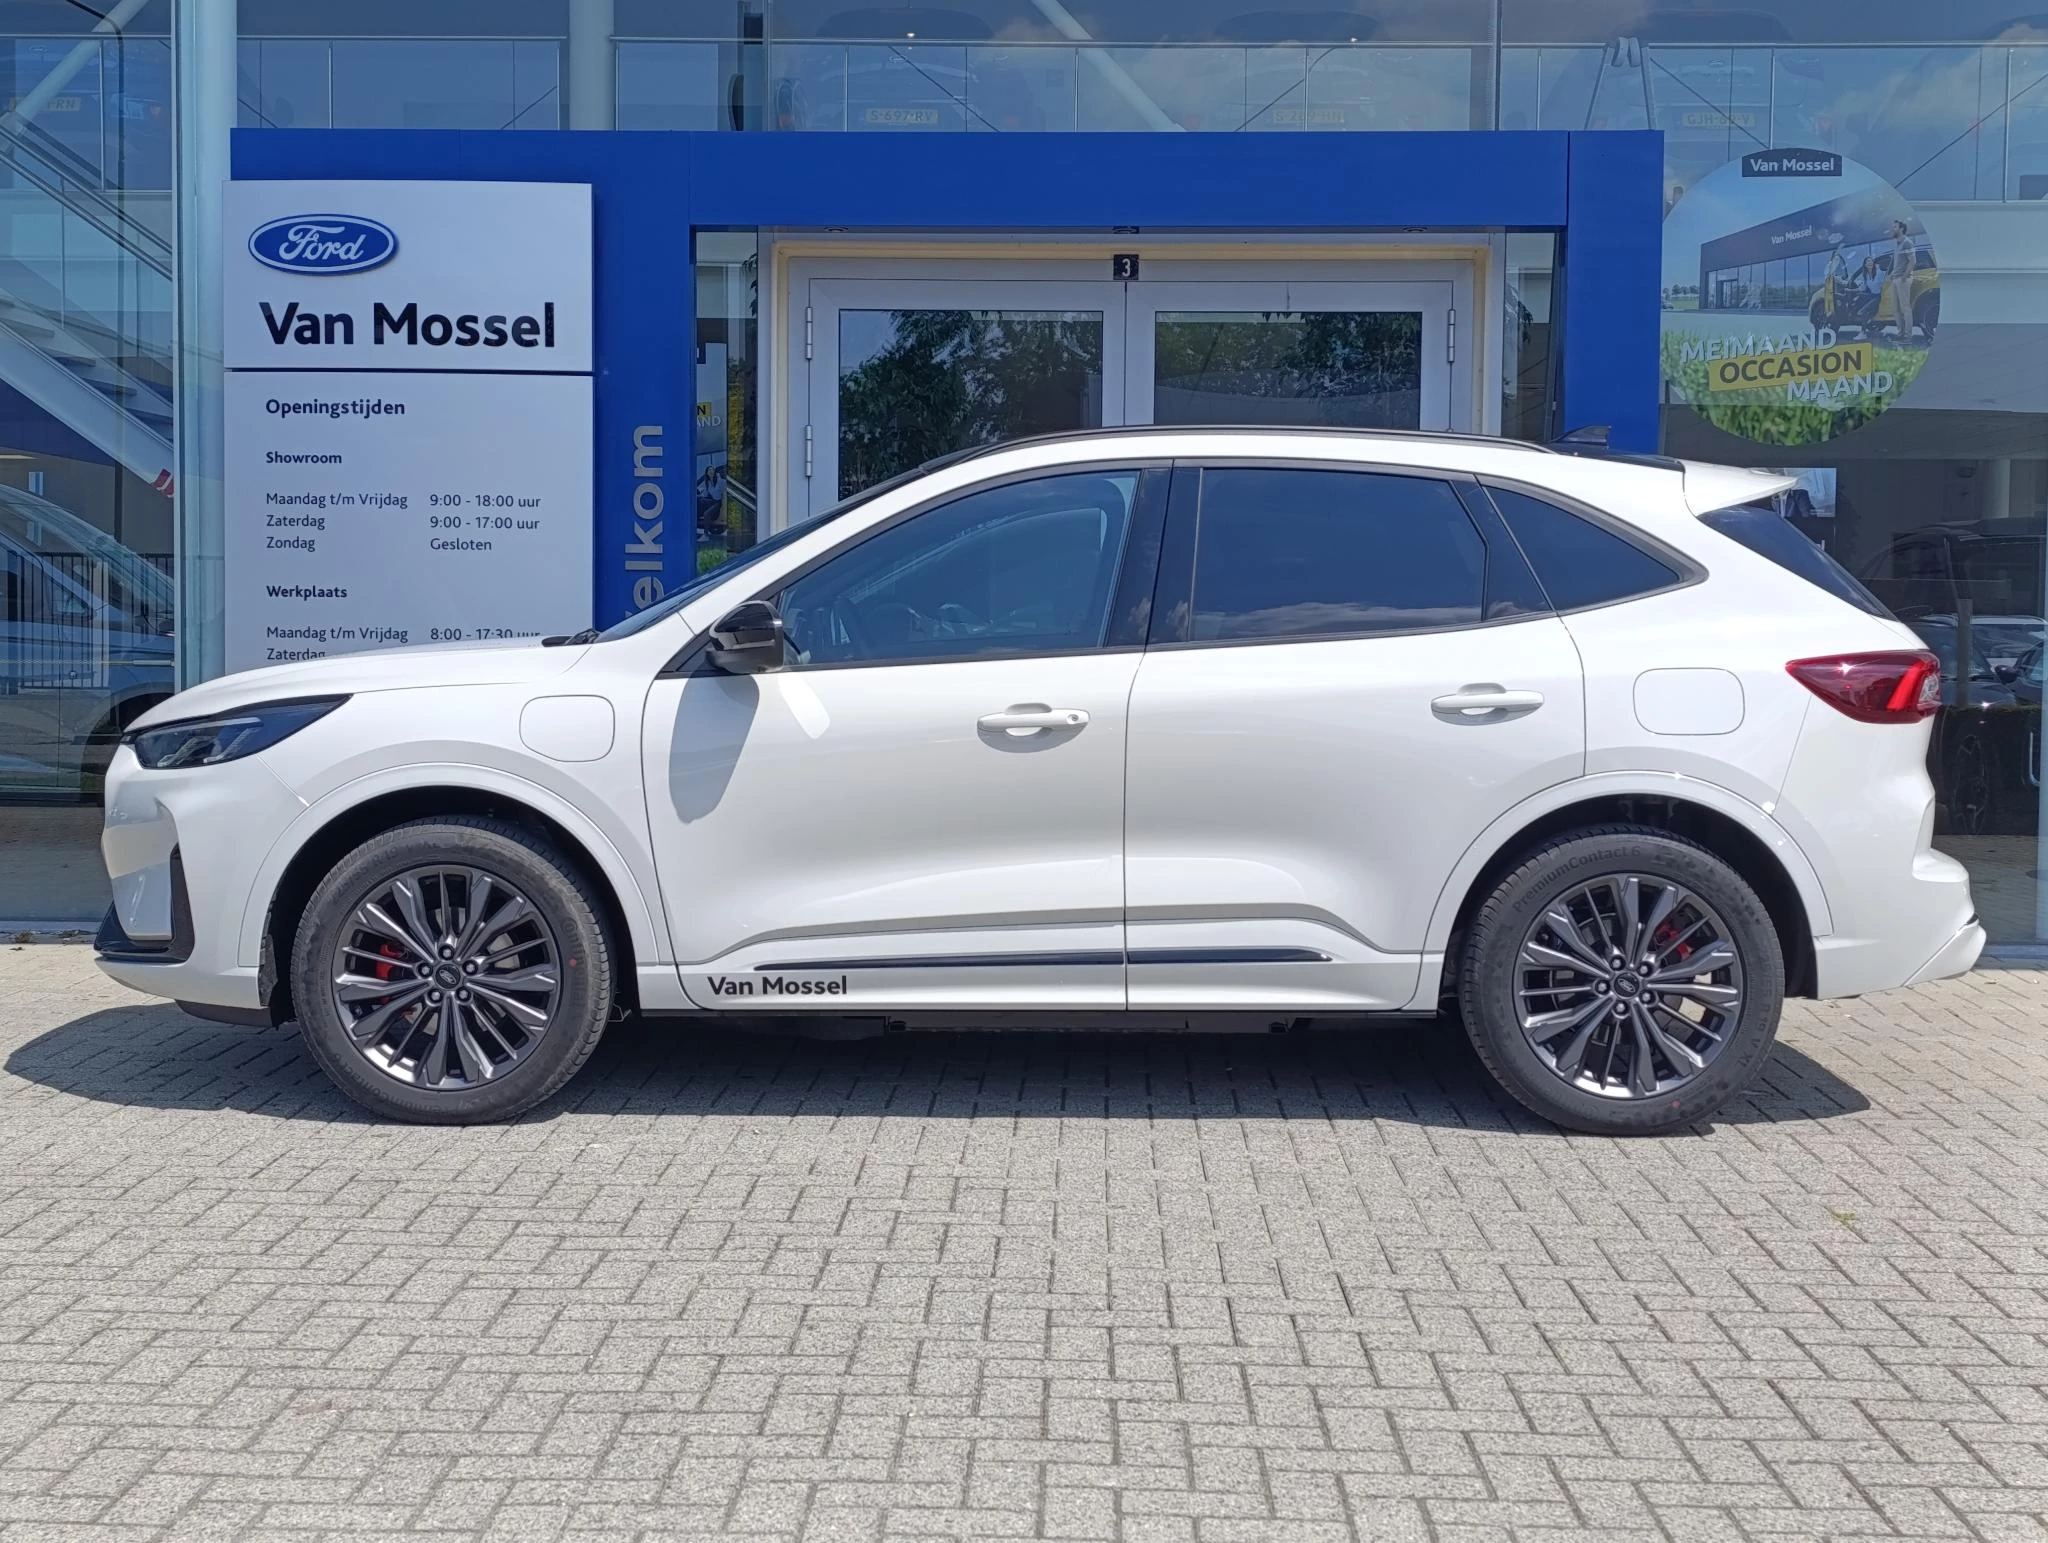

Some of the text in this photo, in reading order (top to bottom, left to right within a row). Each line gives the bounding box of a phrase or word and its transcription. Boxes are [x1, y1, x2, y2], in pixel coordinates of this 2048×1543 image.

[1750, 158, 1833, 171] Van Mossel
[279, 224, 366, 260] Ford
[1122, 258, 1130, 277] 3
[259, 301, 555, 347] Van Mossel
[1679, 328, 1836, 363] MEIMAAND
[1720, 351, 1862, 384] OCCASION
[1787, 372, 1893, 401] MAAND
[265, 399, 405, 418] Openingstijden
[266, 451, 342, 464] Showroom
[266, 493, 326, 508] Maandag
[330, 493, 355, 506] t/m
[359, 493, 408, 510] Vrijdag
[429, 494, 462, 507] 9:00
[476, 495, 514, 508] 18:00
[518, 498, 541, 508] uur
[266, 514, 325, 530] Zaterdag
[429, 516, 462, 529] 9:00
[476, 517, 513, 530] 17:00
[517, 520, 540, 530] uur
[625, 425, 664, 617] elkom
[266, 536, 492, 552] Zondag Gesloten
[266, 585, 348, 601] Werkplaats
[266, 626, 327, 643] Maandag
[330, 627, 355, 640] t/m
[359, 628, 409, 644] Vrijdag
[430, 627, 462, 641] 8:00
[475, 628, 513, 640] 17:30
[707, 975, 847, 995] Van Mossel
